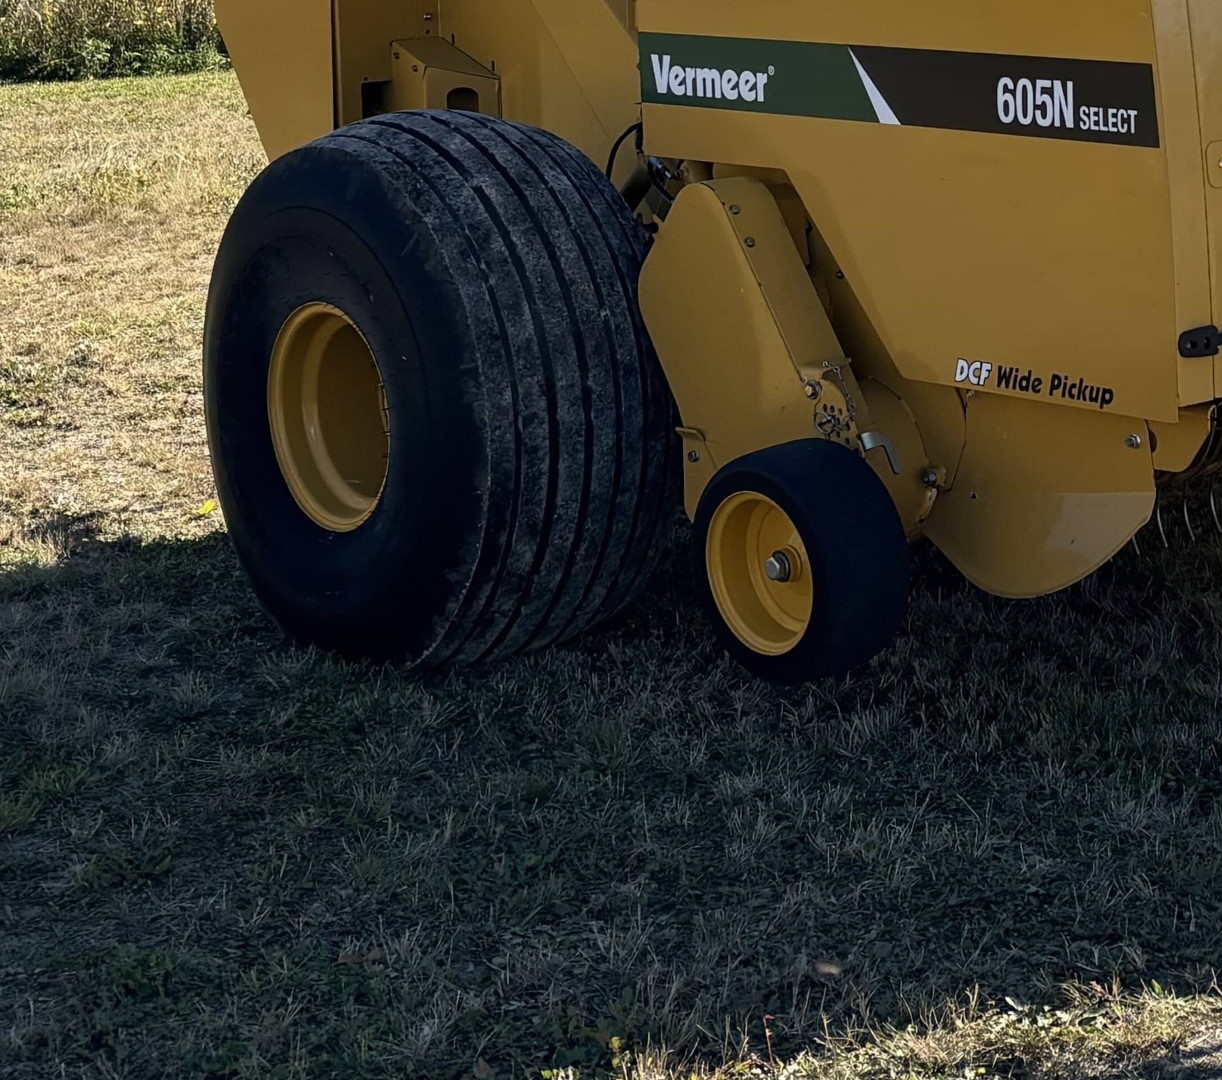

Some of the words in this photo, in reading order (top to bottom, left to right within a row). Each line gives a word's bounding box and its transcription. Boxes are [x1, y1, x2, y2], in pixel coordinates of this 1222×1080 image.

[650, 53, 768, 102] Vermeer
[996, 76, 1075, 129] 605N
[1079, 105, 1138, 135] SELECT
[954, 357, 993, 387] DCF
[997, 365, 1043, 394] Wide
[1049, 373, 1114, 409] Pickup
